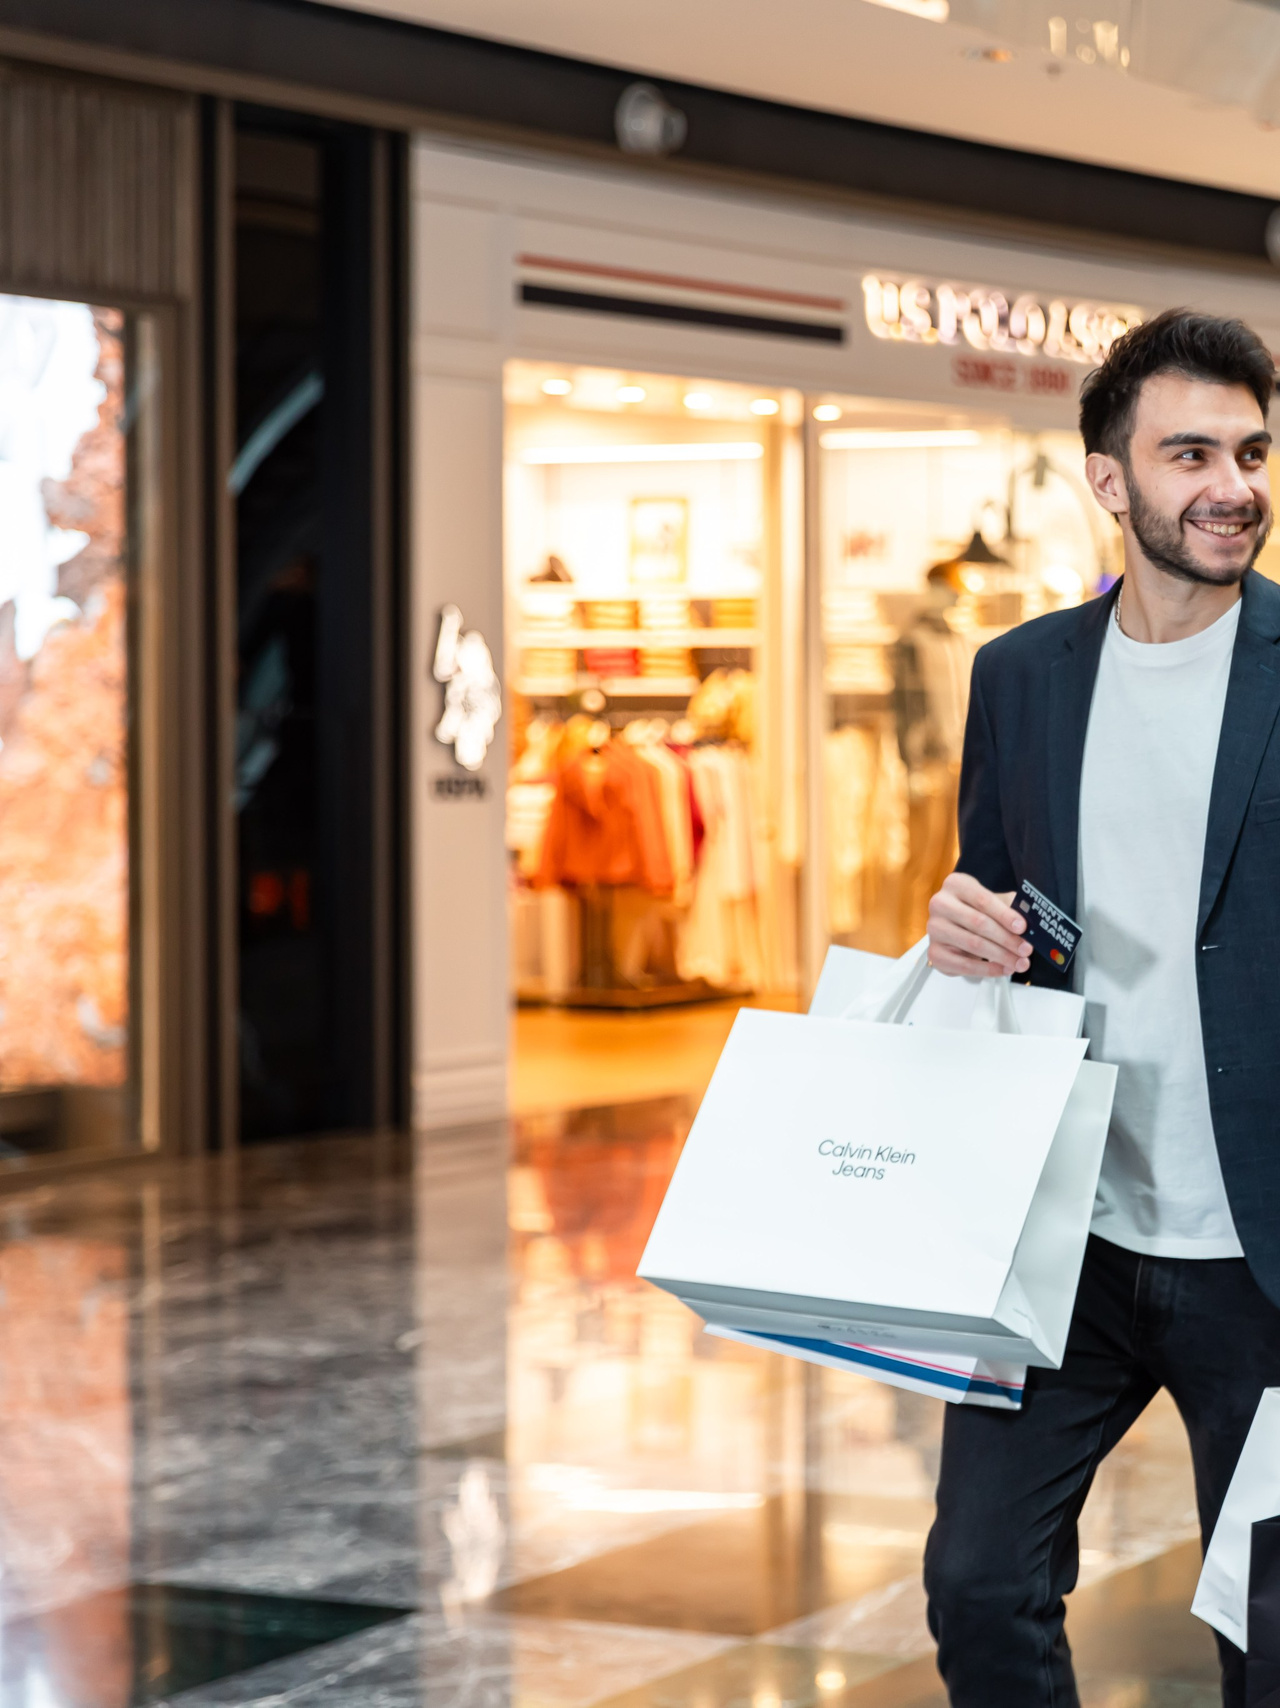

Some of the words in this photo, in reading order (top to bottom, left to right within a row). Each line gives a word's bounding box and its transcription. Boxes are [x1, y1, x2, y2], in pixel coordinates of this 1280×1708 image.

[1021, 883, 1064, 922] ORIENT
[1031, 902, 1076, 943] FINANS
[1039, 919, 1074, 952] BANK
[818, 1139, 873, 1160] Calvin
[874, 1146, 916, 1165] Klein
[832, 1160, 886, 1180] Jeans
